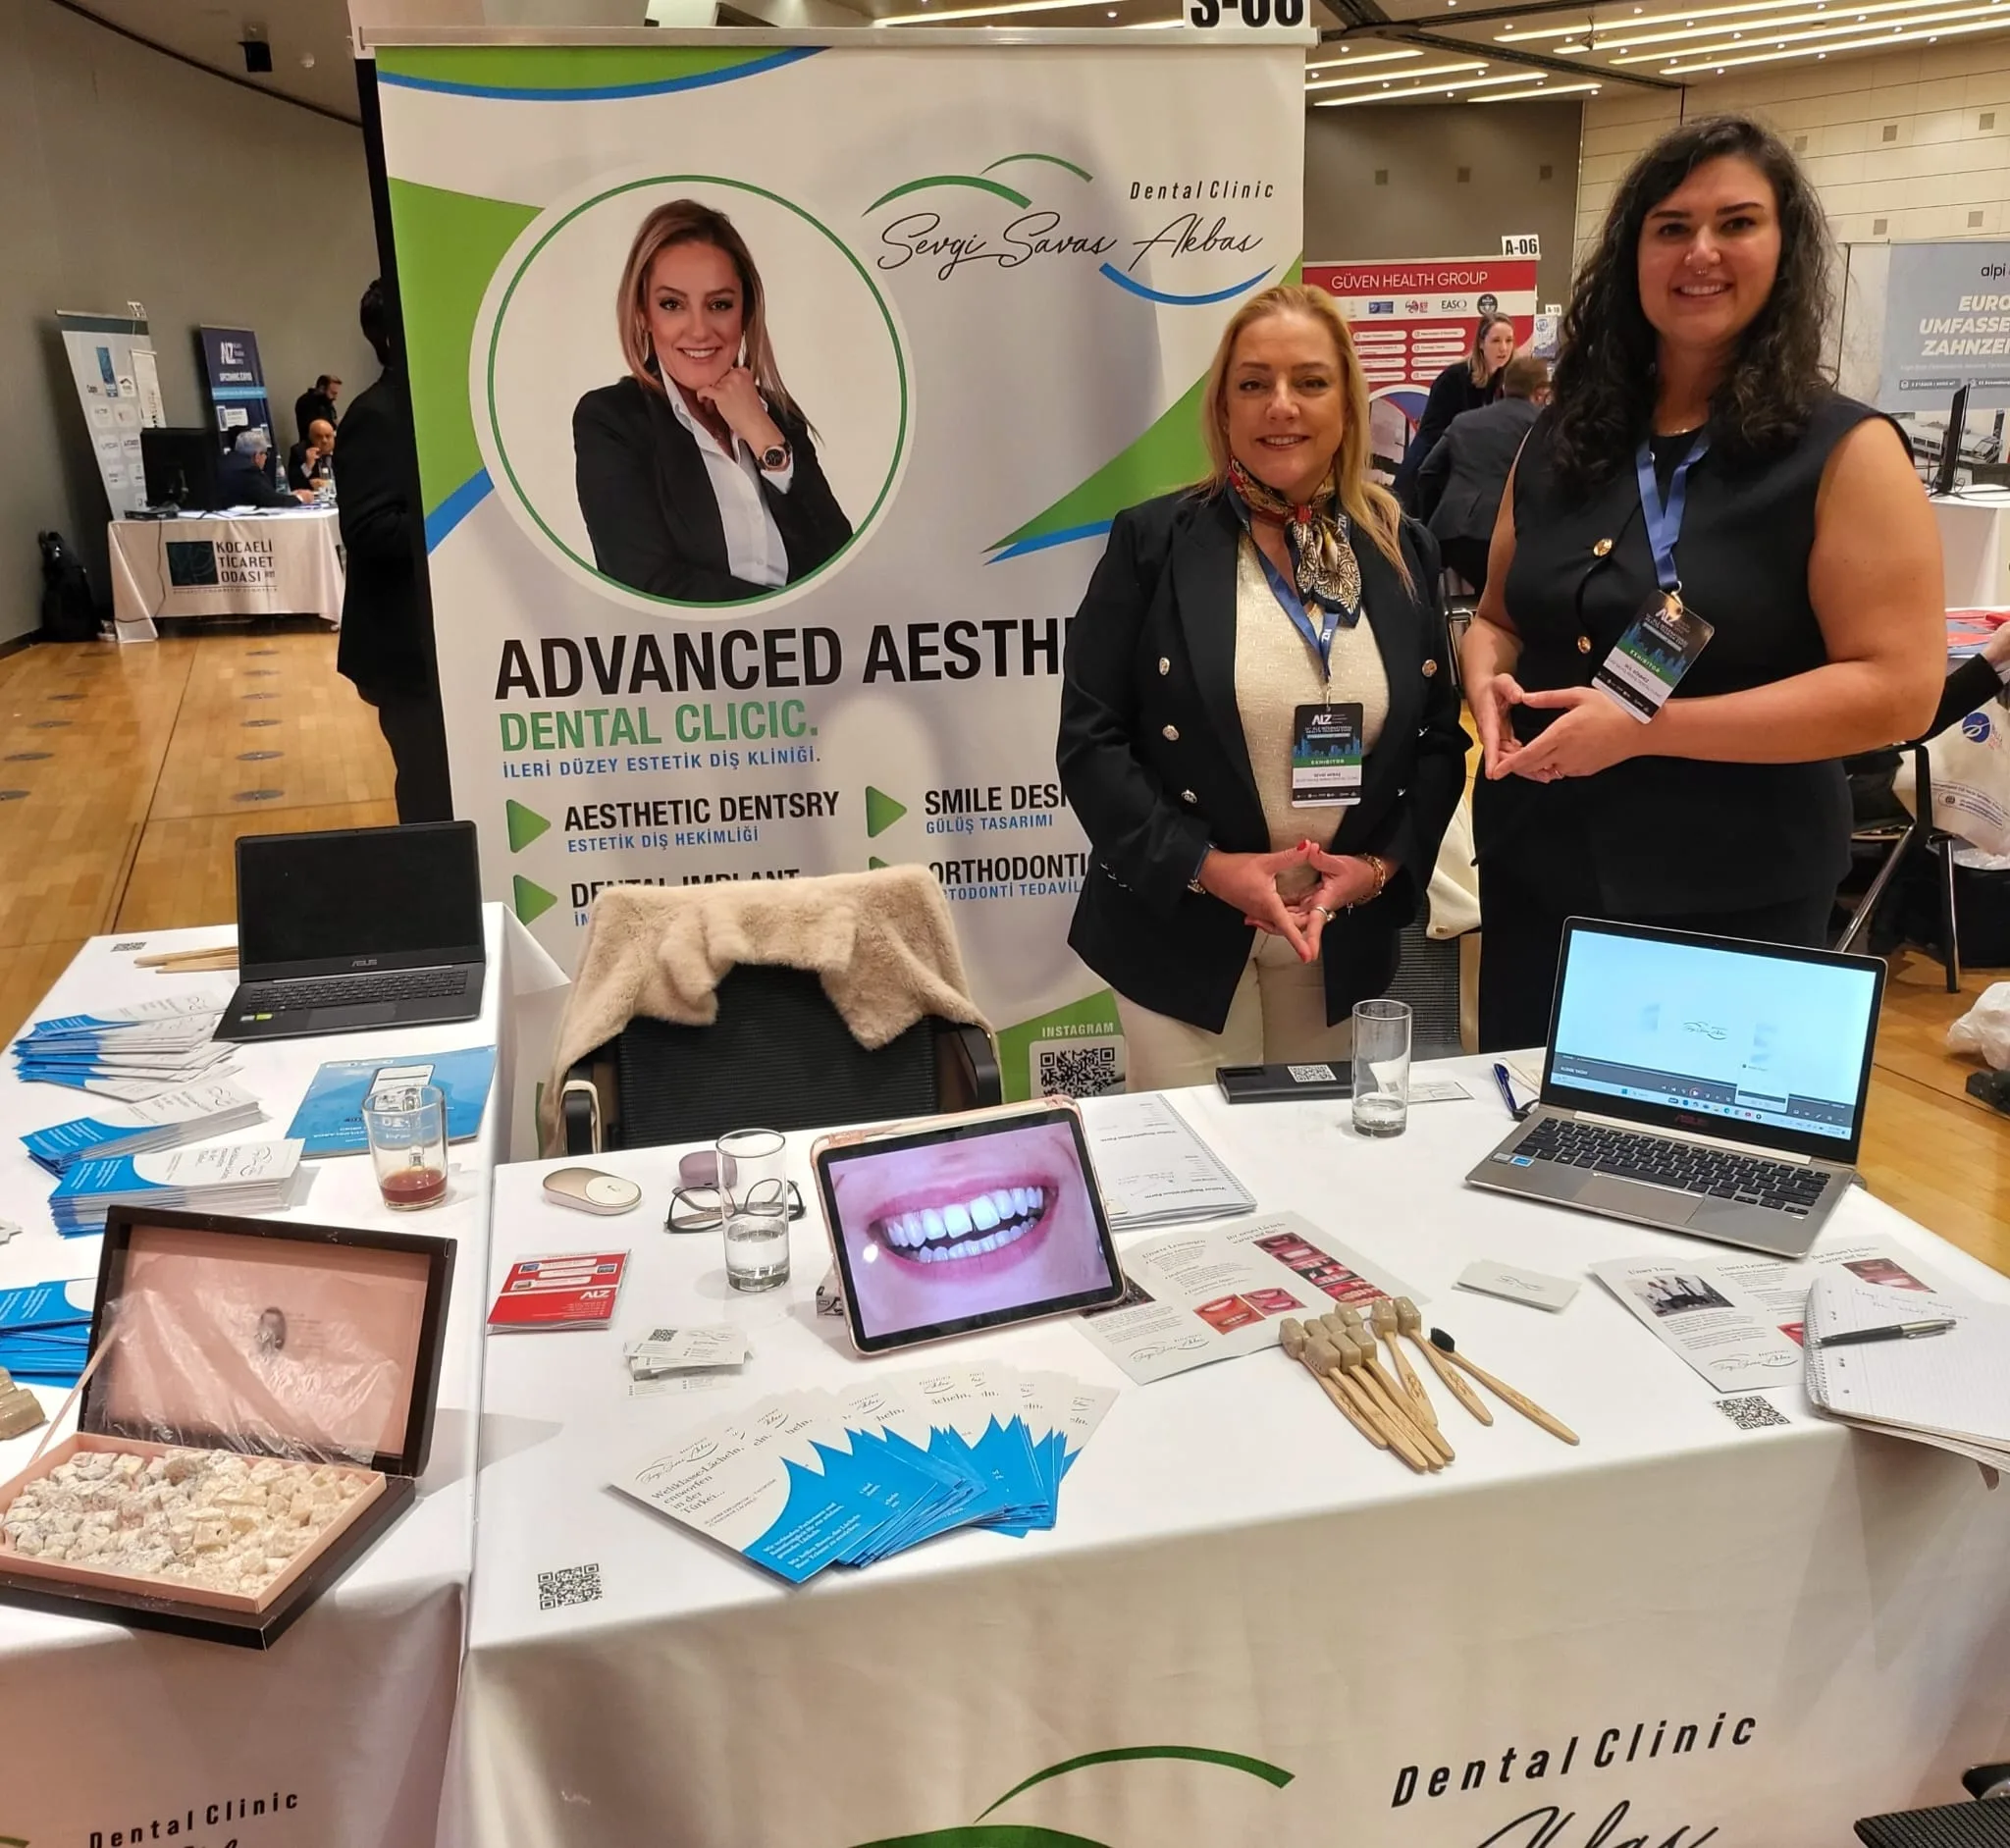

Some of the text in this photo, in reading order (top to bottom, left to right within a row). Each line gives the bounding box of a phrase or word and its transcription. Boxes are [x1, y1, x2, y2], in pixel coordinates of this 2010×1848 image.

[1130, 180, 1275, 200] Dental Clinic
[877, 211, 1264, 281] Sevgi Savas Akbas
[1505, 238, 1539, 256] A-06
[1332, 271, 1488, 290] GÜVEN HEALTH GROUP
[1981, 262, 2006, 281] alpi
[1958, 294, 2010, 312] EURO
[1919, 316, 2010, 335] UMFASSE
[216, 538, 273, 554] KOCAELİ
[218, 554, 274, 568] TİCARET
[221, 571, 261, 583] ODASI
[494, 616, 1075, 700] ADVANCED AESTH
[500, 699, 819, 752] DENTAL CLICIC.
[502, 744, 821, 778] İLERİ DÜZEY ESTETİK DİŞ KLİNİĞİ.
[925, 786, 1002, 816] SMILE
[564, 791, 839, 832] AESTHETIC DENTSRY
[926, 814, 1053, 834] GÜLÜŞ TASARIMI
[567, 828, 759, 853] ESTETİK DİŞ HEKİMLİĞİ
[1042, 1023, 1114, 1037] INSTAGRAM
[663, 1475, 714, 1505] entworfen
[1392, 1712, 1757, 1808] Dental Clinic
[89, 1792, 298, 1848] Dental Clinic
